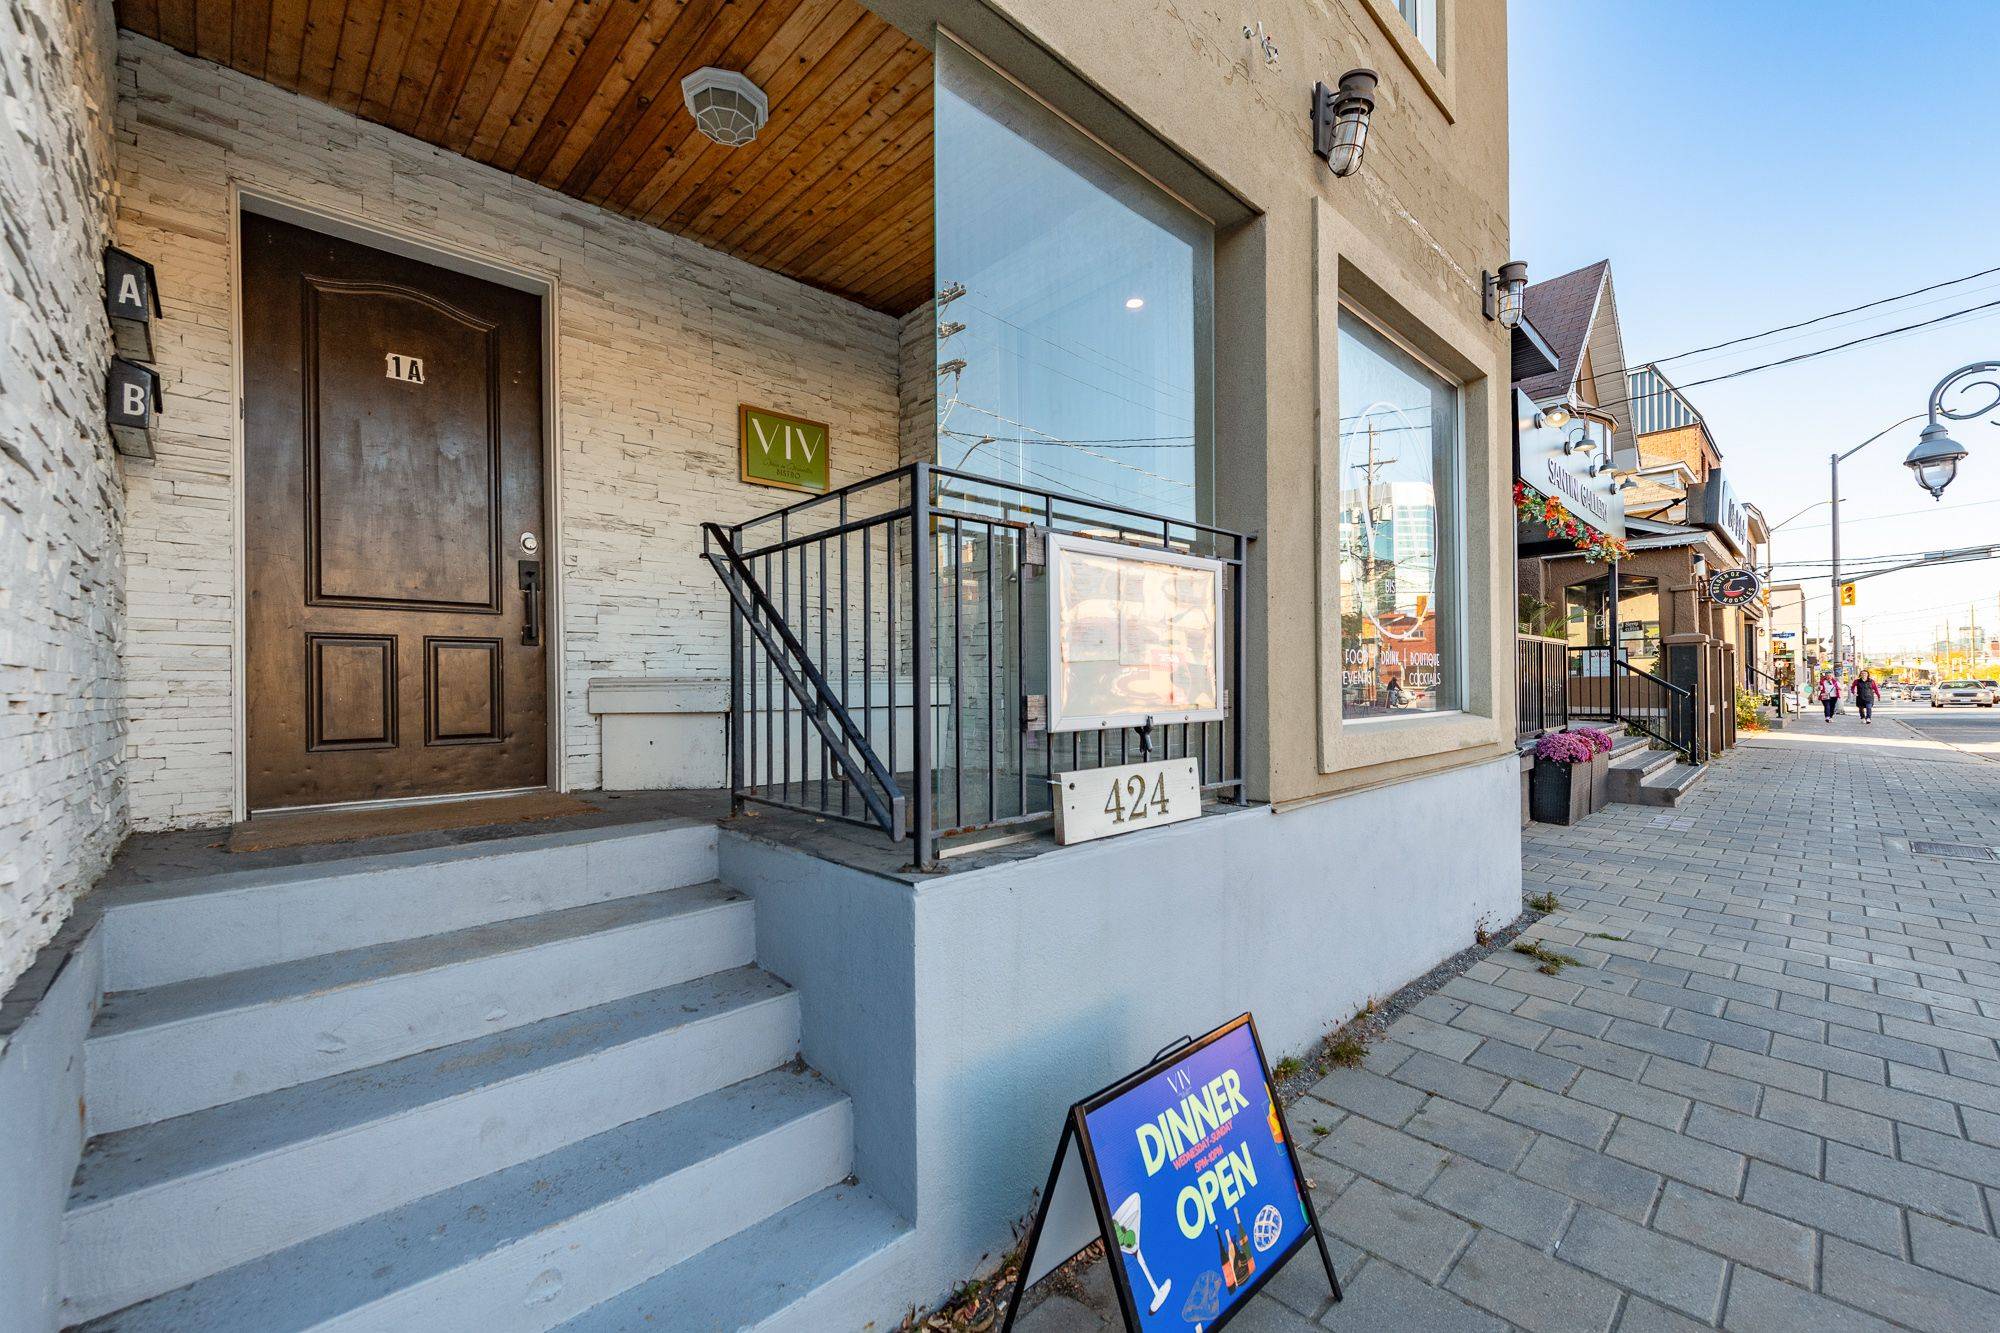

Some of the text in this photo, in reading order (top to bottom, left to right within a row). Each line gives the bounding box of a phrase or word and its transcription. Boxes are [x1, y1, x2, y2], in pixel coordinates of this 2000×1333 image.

[118, 273, 142, 307] A
[391, 355, 422, 382] 1A
[123, 383, 146, 416] B
[752, 418, 822, 464] VIV
[1722, 587, 1755, 603] NOODLES
[1345, 648, 1440, 667] FOOD DRINK BOUTIQUE
[1409, 672, 1441, 686] COCKTAILS
[1104, 772, 1170, 825] 424
[1167, 1066, 1191, 1093] VIV
[1135, 1068, 1250, 1178] DINNER
[1176, 1140, 1258, 1240] OPEN
